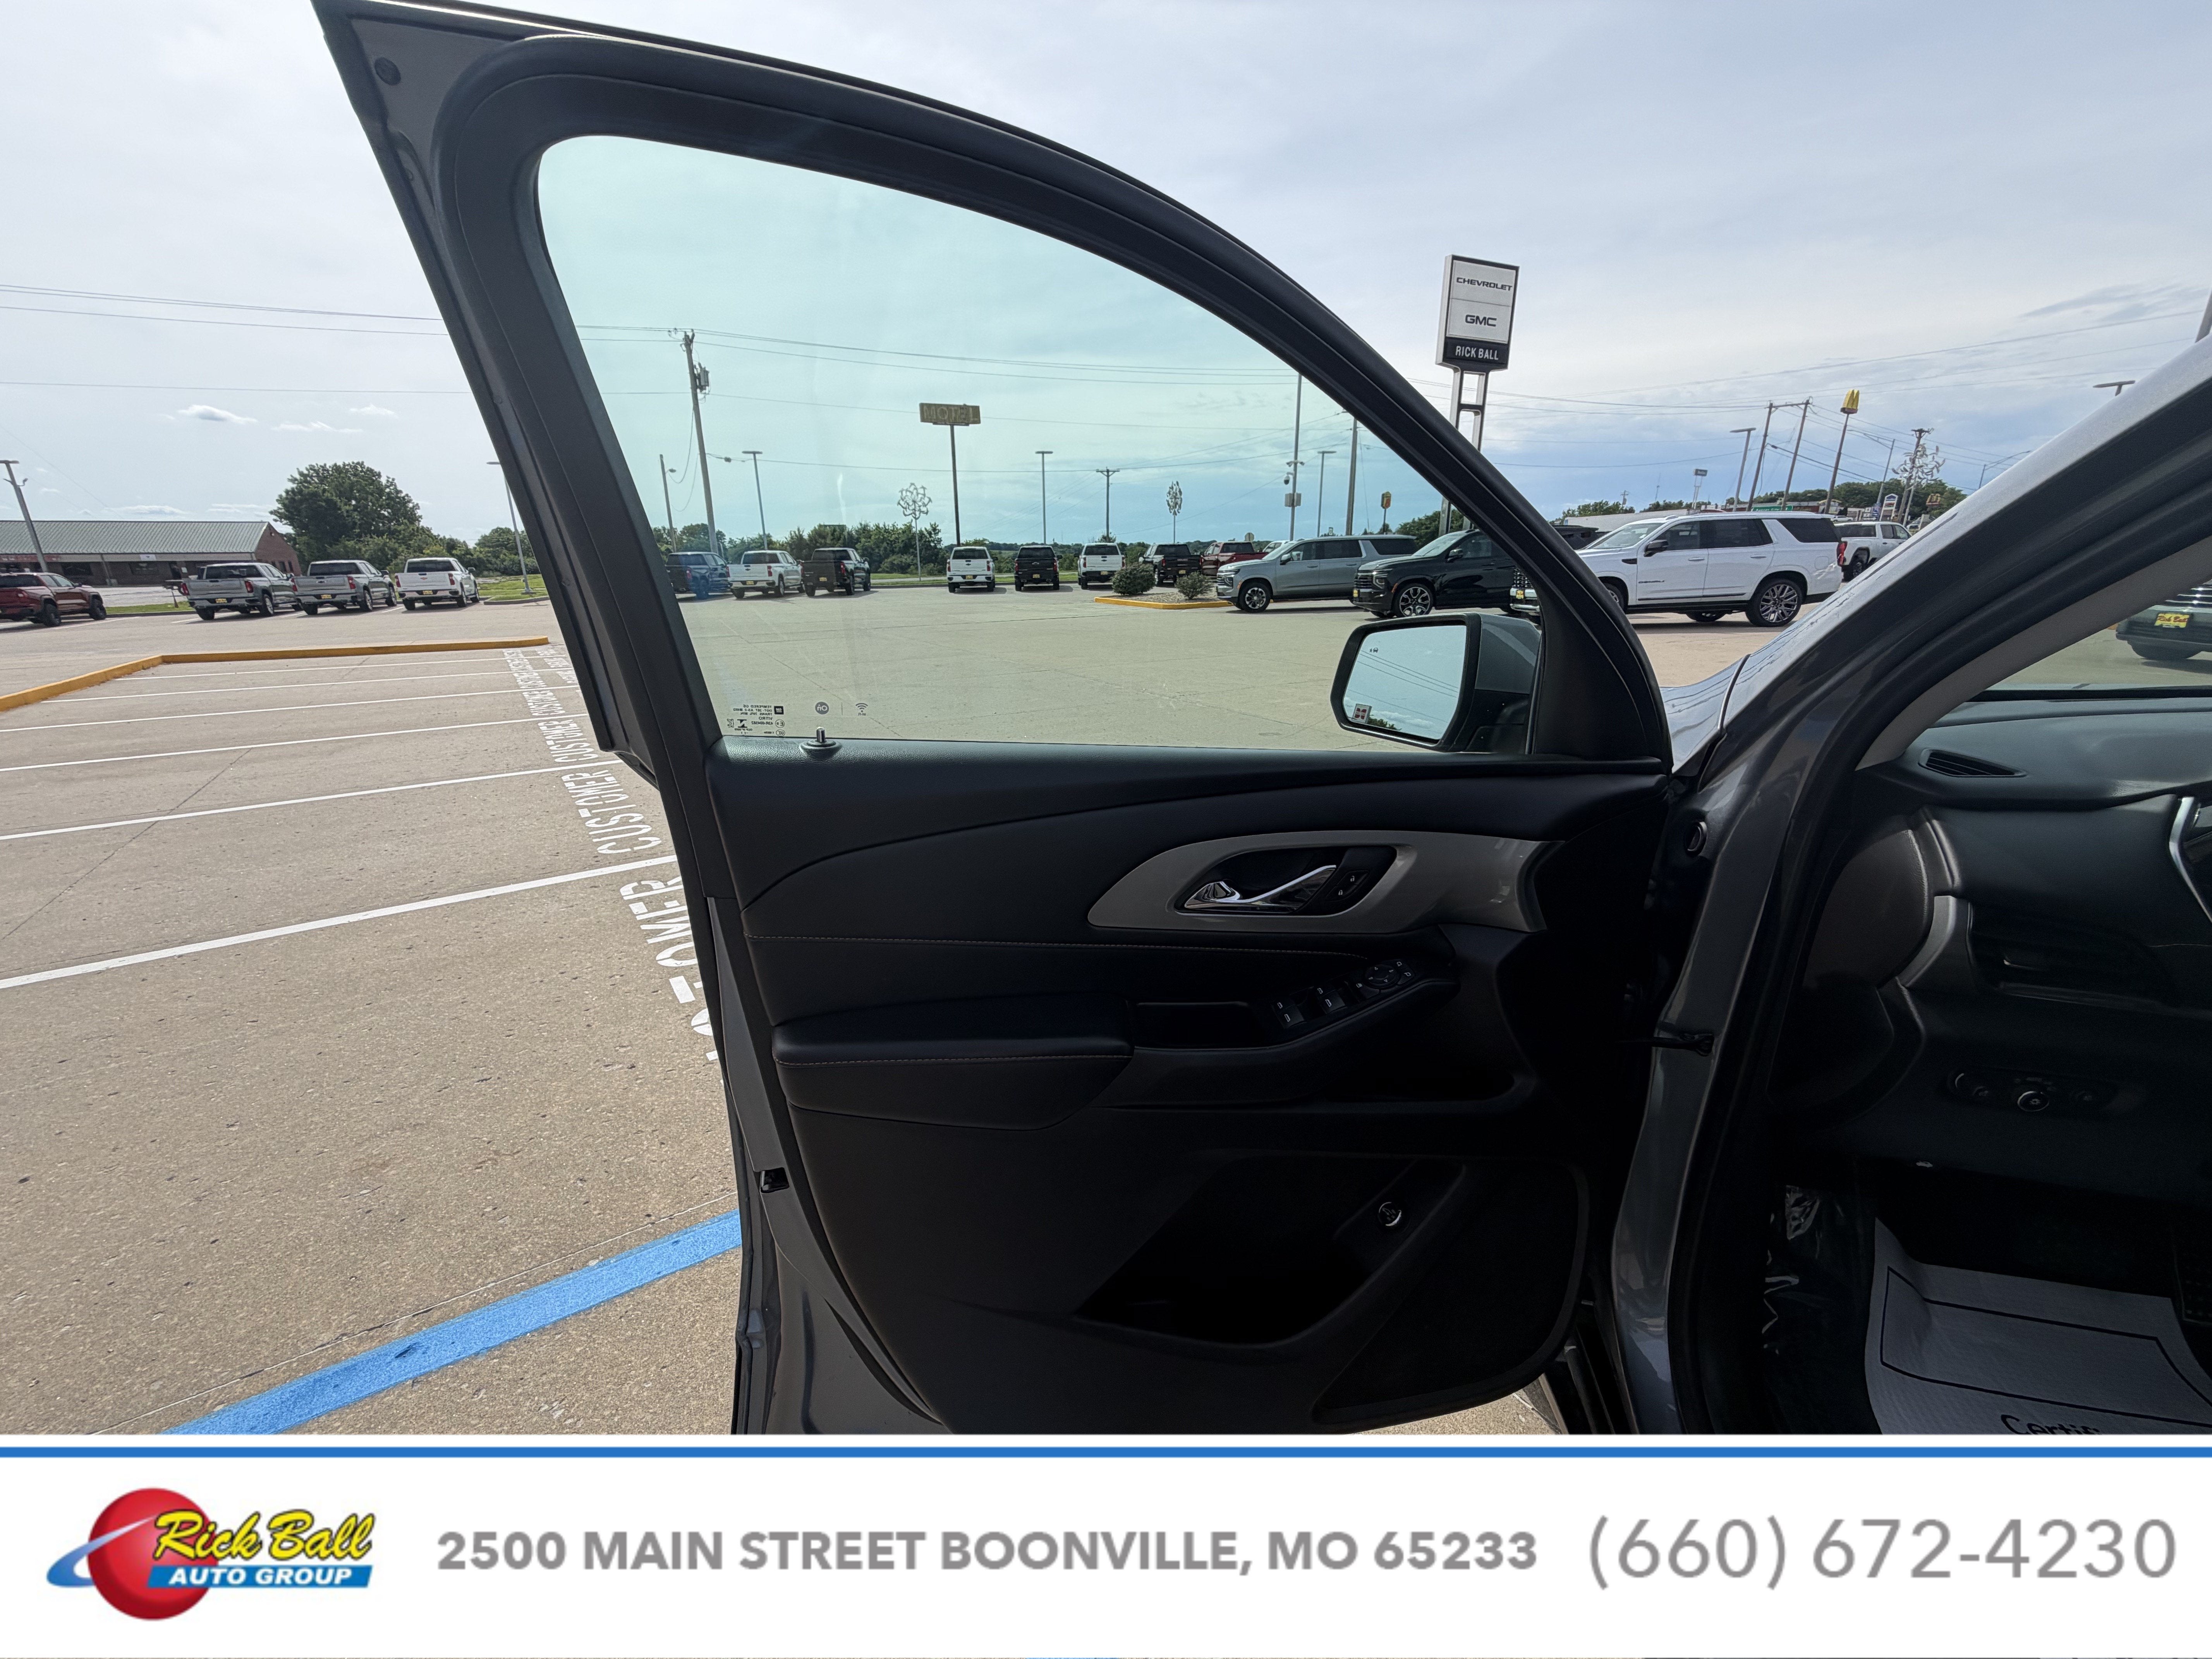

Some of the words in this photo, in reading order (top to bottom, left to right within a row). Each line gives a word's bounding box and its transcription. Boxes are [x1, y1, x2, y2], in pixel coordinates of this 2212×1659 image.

[1456, 277, 1513, 291] CHEVROLET
[1465, 314, 1497, 327] GMC
[1455, 345, 1476, 358] RICK
[1478, 348, 1499, 360] BALL
[923, 407, 979, 421] MOTEL
[522, 690, 565, 716] CUSTOMER
[538, 719, 598, 762] CUSTOMER
[561, 769, 662, 854] CUSTOMER
